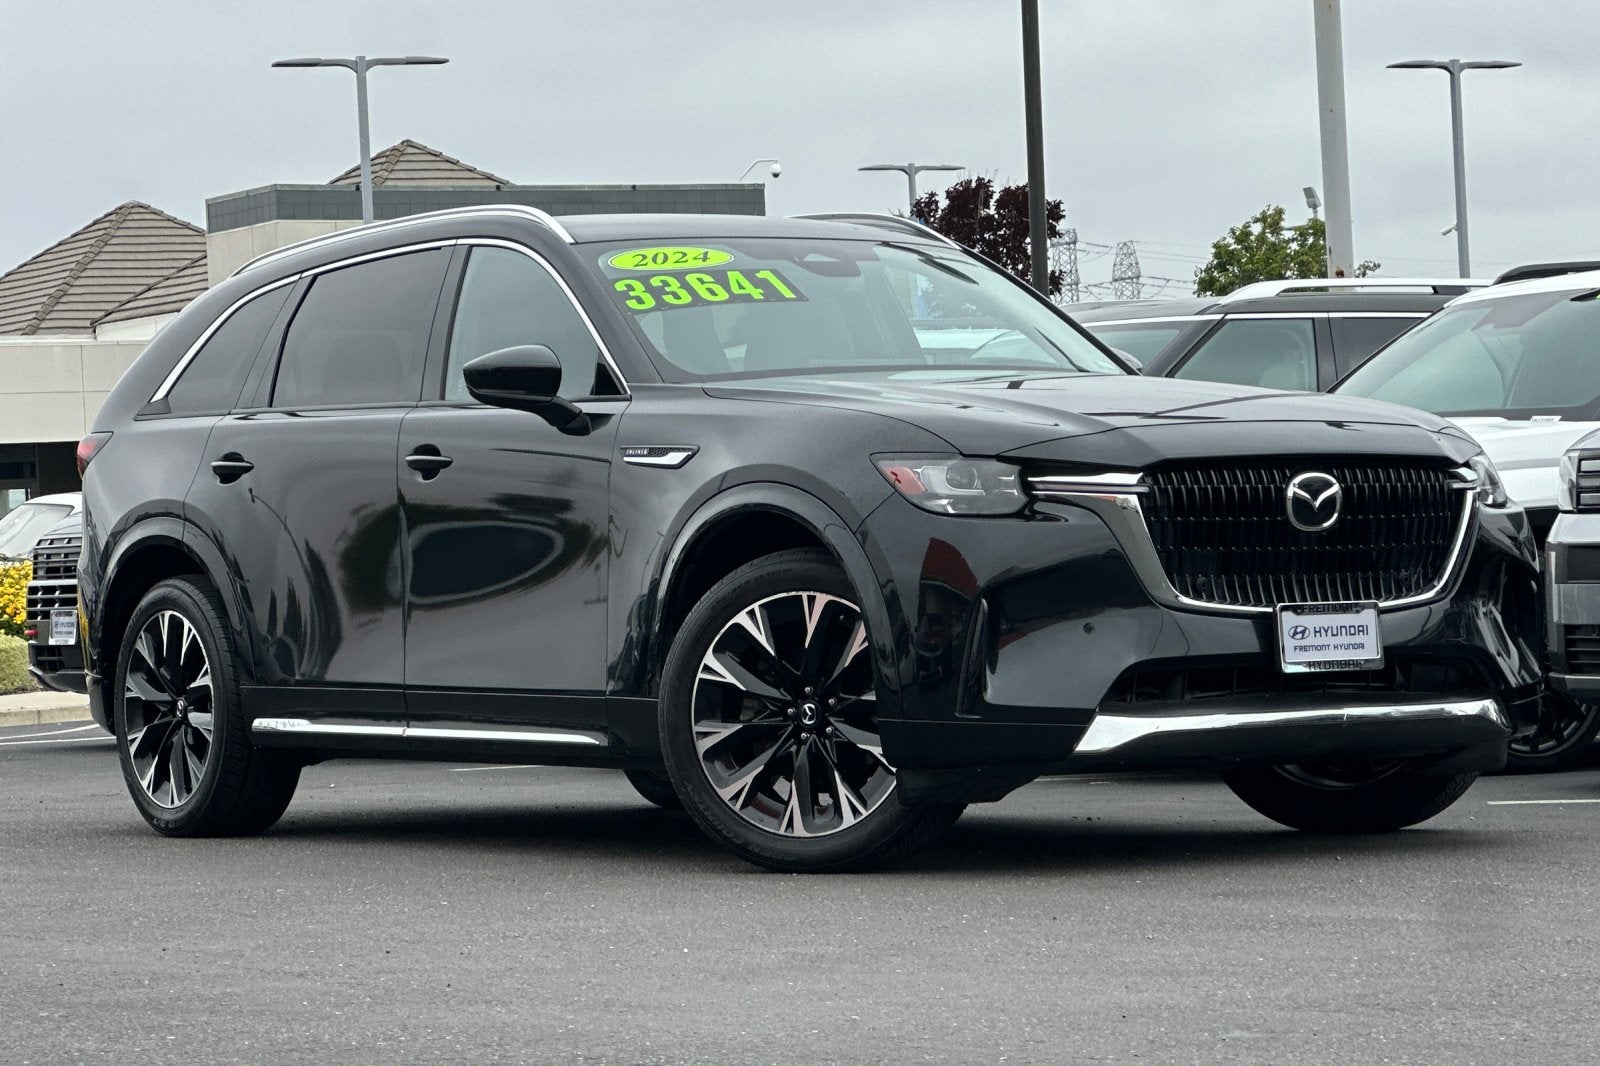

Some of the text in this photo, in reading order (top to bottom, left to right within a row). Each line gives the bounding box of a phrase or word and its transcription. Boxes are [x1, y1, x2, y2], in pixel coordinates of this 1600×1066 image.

[632, 250, 711, 268] 2024
[613, 270, 797, 310] 33641
[1314, 625, 1369, 637] HYUNDAI
[1294, 644, 1330, 652] FREMONT
